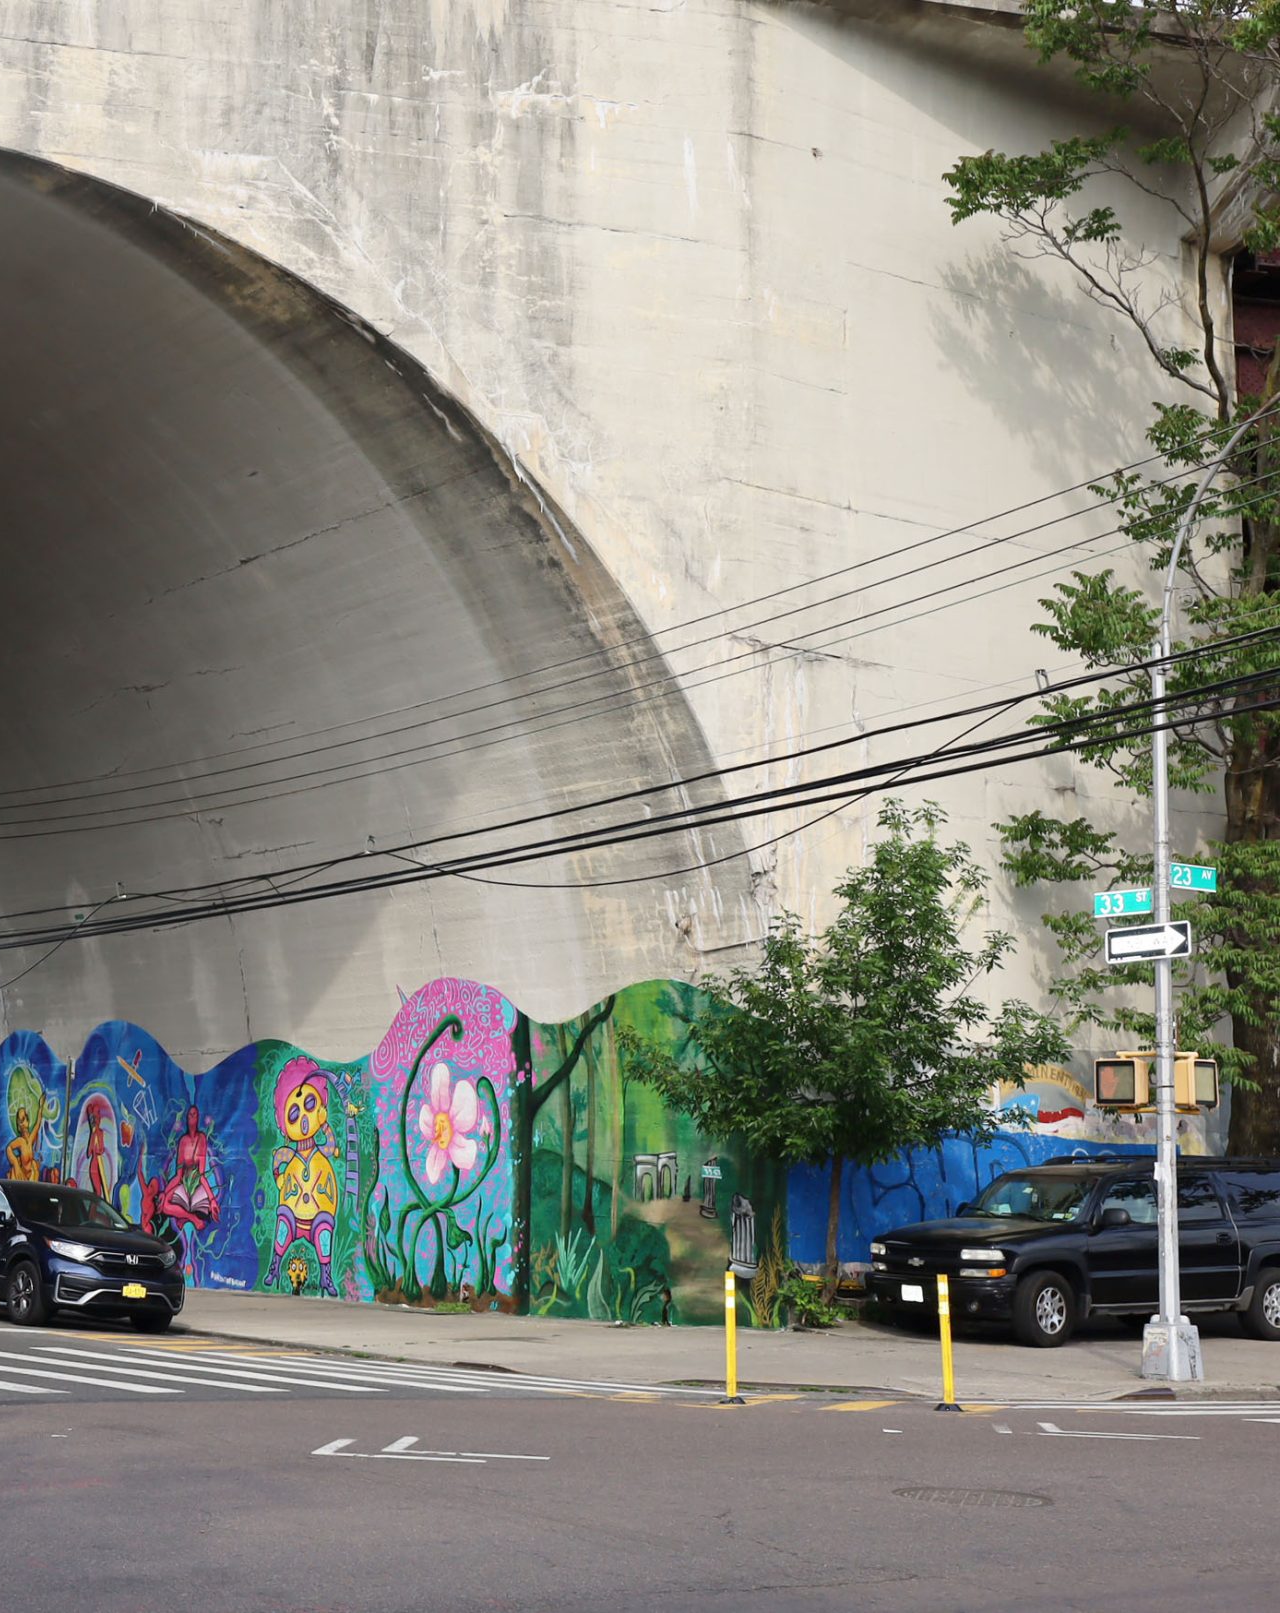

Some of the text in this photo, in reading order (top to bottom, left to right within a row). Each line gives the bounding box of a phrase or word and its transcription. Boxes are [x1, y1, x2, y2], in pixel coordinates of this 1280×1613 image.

[1173, 866, 1212, 886] 23 AV
[1100, 892, 1147, 914] 33 ST
